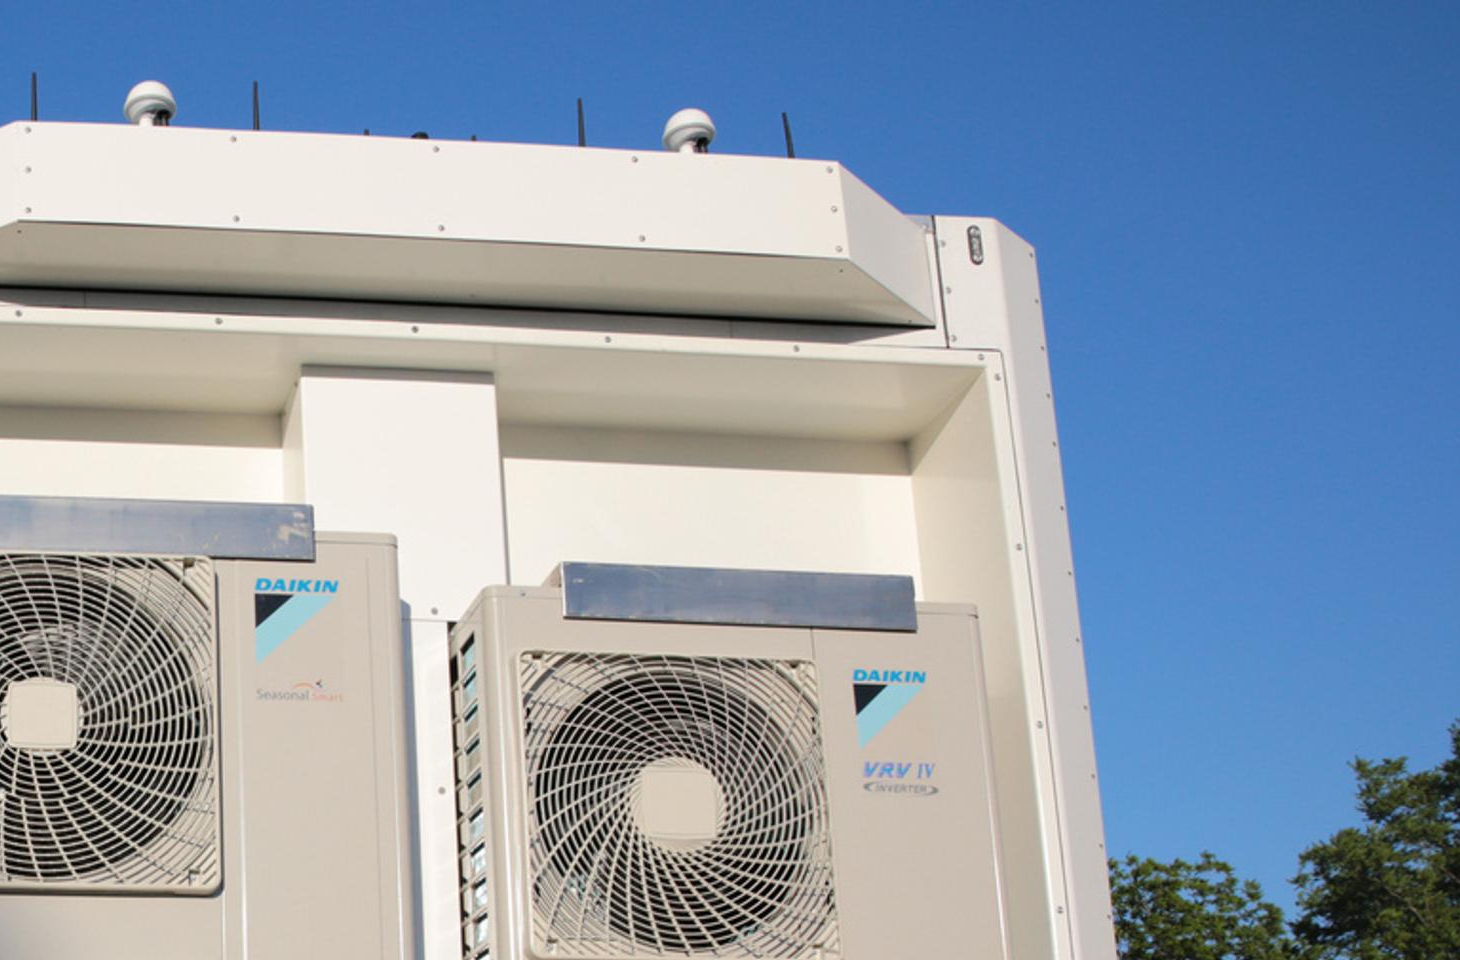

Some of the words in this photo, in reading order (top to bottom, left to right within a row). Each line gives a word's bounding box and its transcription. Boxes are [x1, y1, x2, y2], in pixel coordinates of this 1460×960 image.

[255, 578, 339, 592] DAIKIN
[853, 669, 926, 683] DAIKIN
[256, 687, 309, 701] Seasonal
[863, 762, 912, 778] VRV
[917, 763, 935, 779] IV
[876, 783, 927, 794] INVERTER
